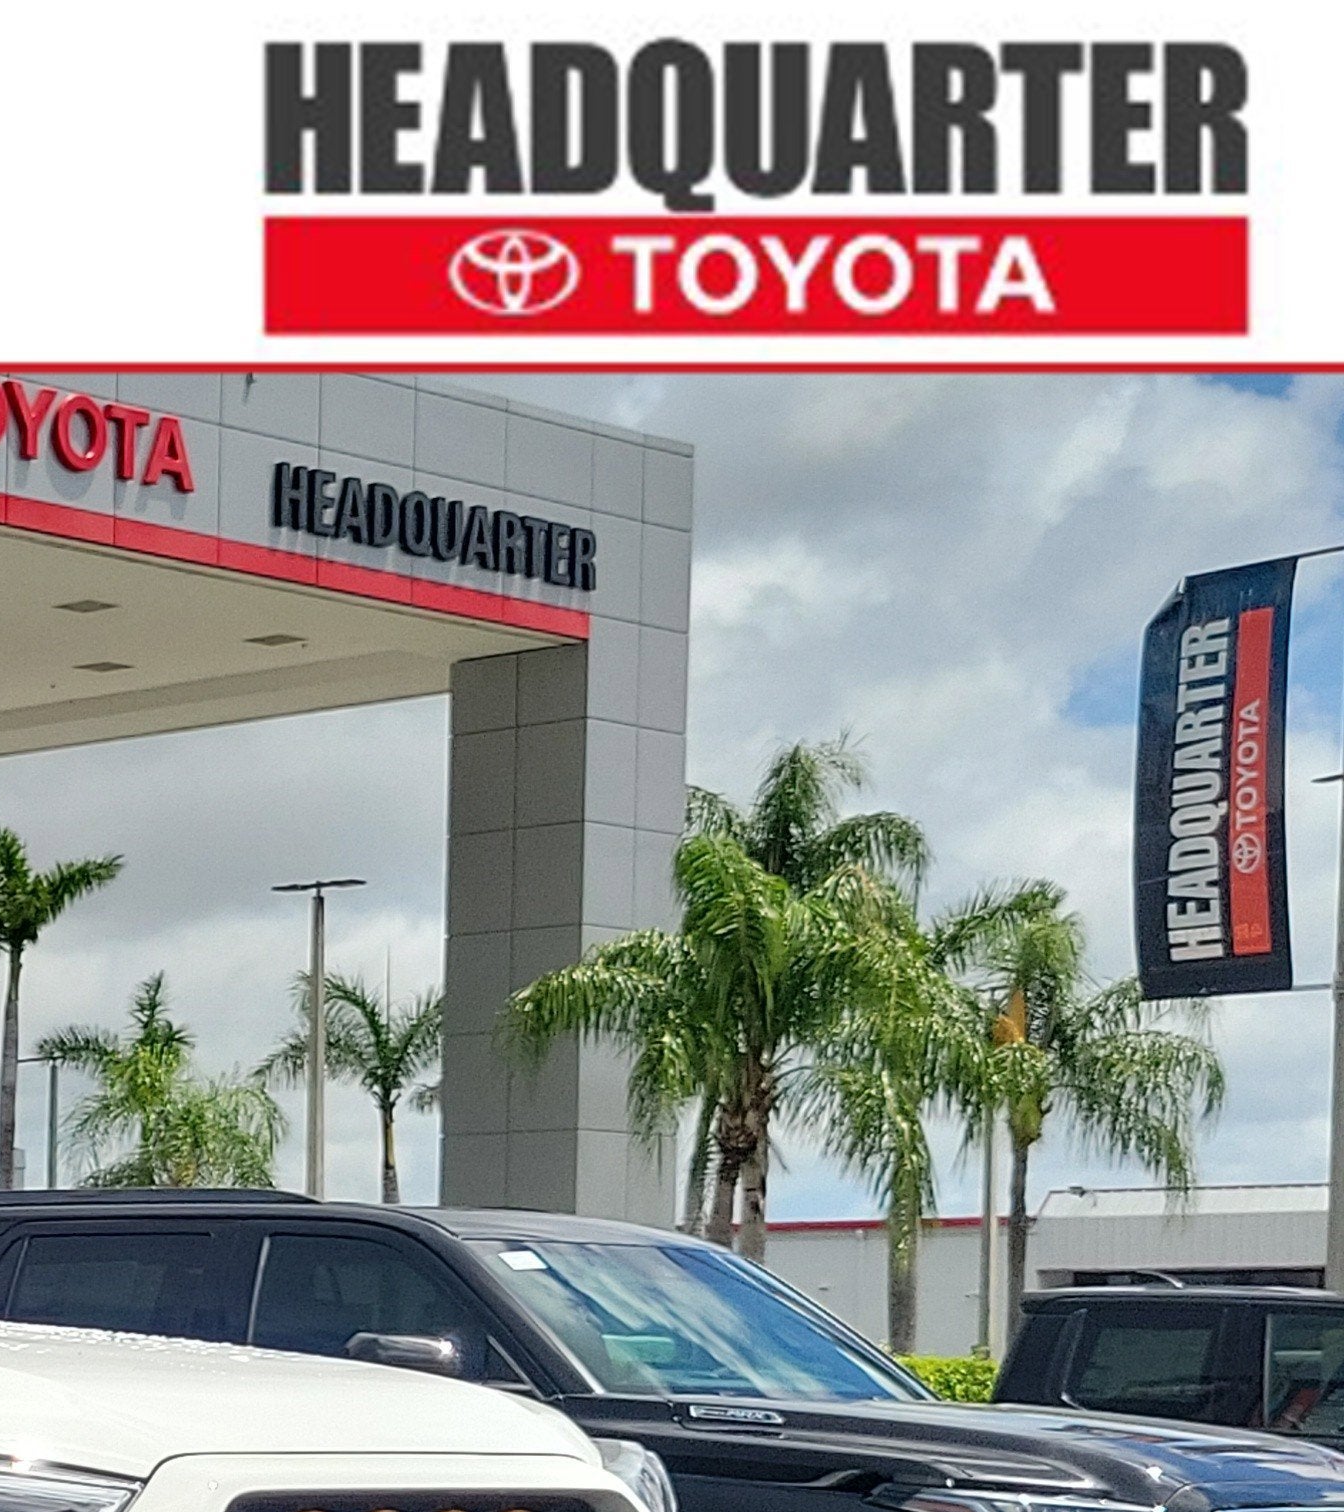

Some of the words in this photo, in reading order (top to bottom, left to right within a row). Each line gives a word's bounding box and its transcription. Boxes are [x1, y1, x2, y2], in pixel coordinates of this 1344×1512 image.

[273, 461, 598, 591] HEADQUARTER
[1166, 616, 1230, 962] HEADQUARTER
[1235, 698, 1261, 831] TOYOTA
